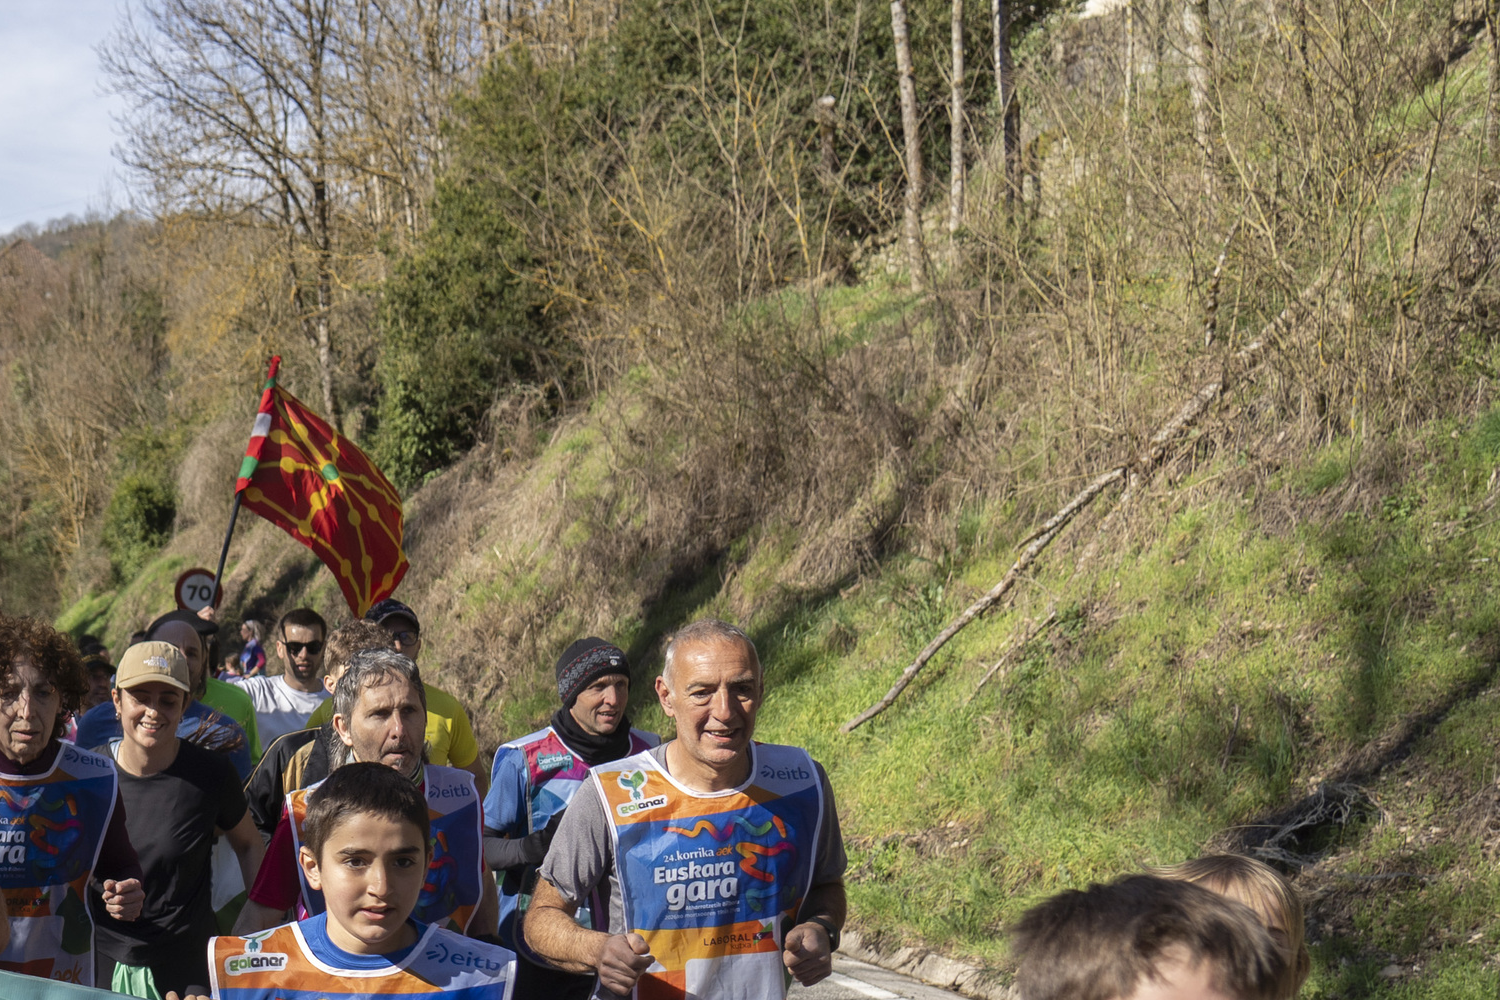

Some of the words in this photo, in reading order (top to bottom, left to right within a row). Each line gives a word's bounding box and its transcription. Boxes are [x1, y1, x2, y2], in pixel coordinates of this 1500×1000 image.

[187, 585, 211, 601] 70
[777, 768, 810, 781] eitb
[443, 784, 471, 799] eitb
[620, 797, 666, 815] goiener
[663, 846, 715, 863] 24.korrika
[653, 860, 736, 884] Euskara
[666, 876, 739, 911] gara
[703, 933, 751, 947] LABORAL
[229, 955, 285, 972] goiener
[450, 952, 501, 972] eitb
